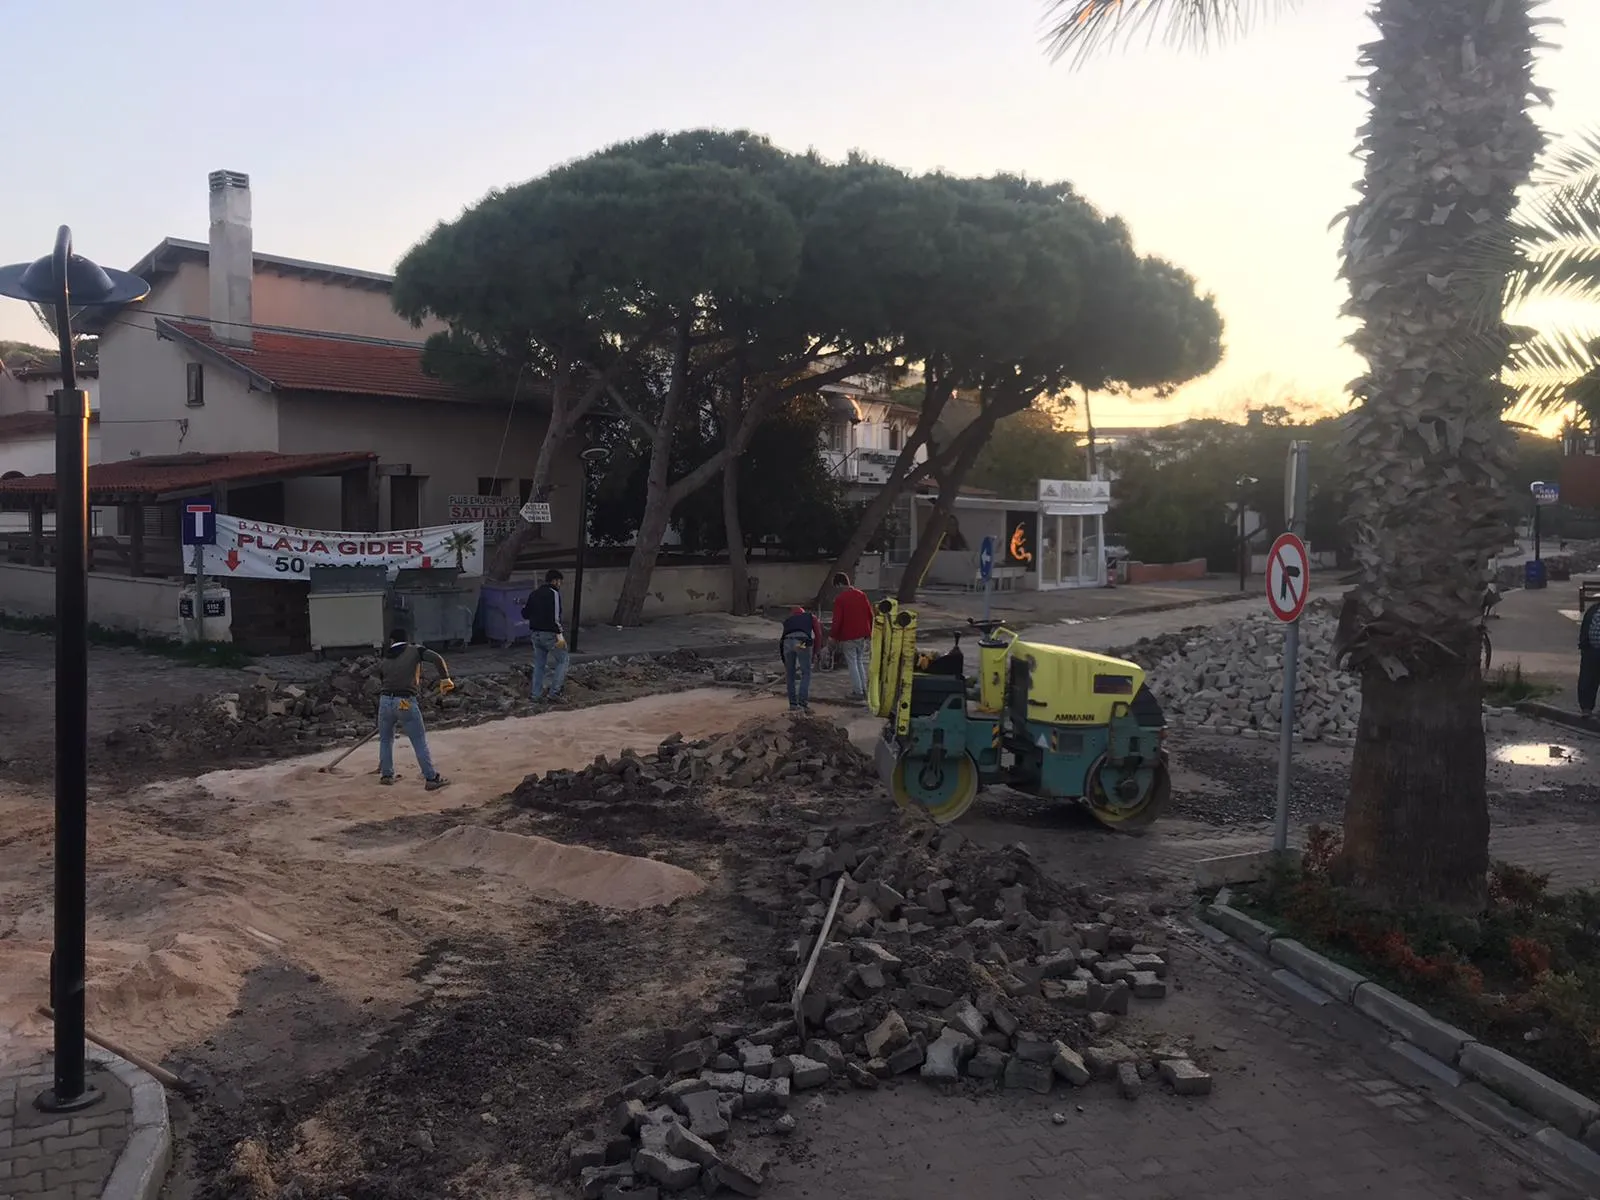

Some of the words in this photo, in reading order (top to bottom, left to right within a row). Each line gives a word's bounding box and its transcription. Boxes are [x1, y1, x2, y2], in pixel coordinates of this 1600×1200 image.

[237, 533, 330, 554] PLAJA
[275, 557, 305, 573] 50
[1054, 713, 1096, 721] AMMANN
